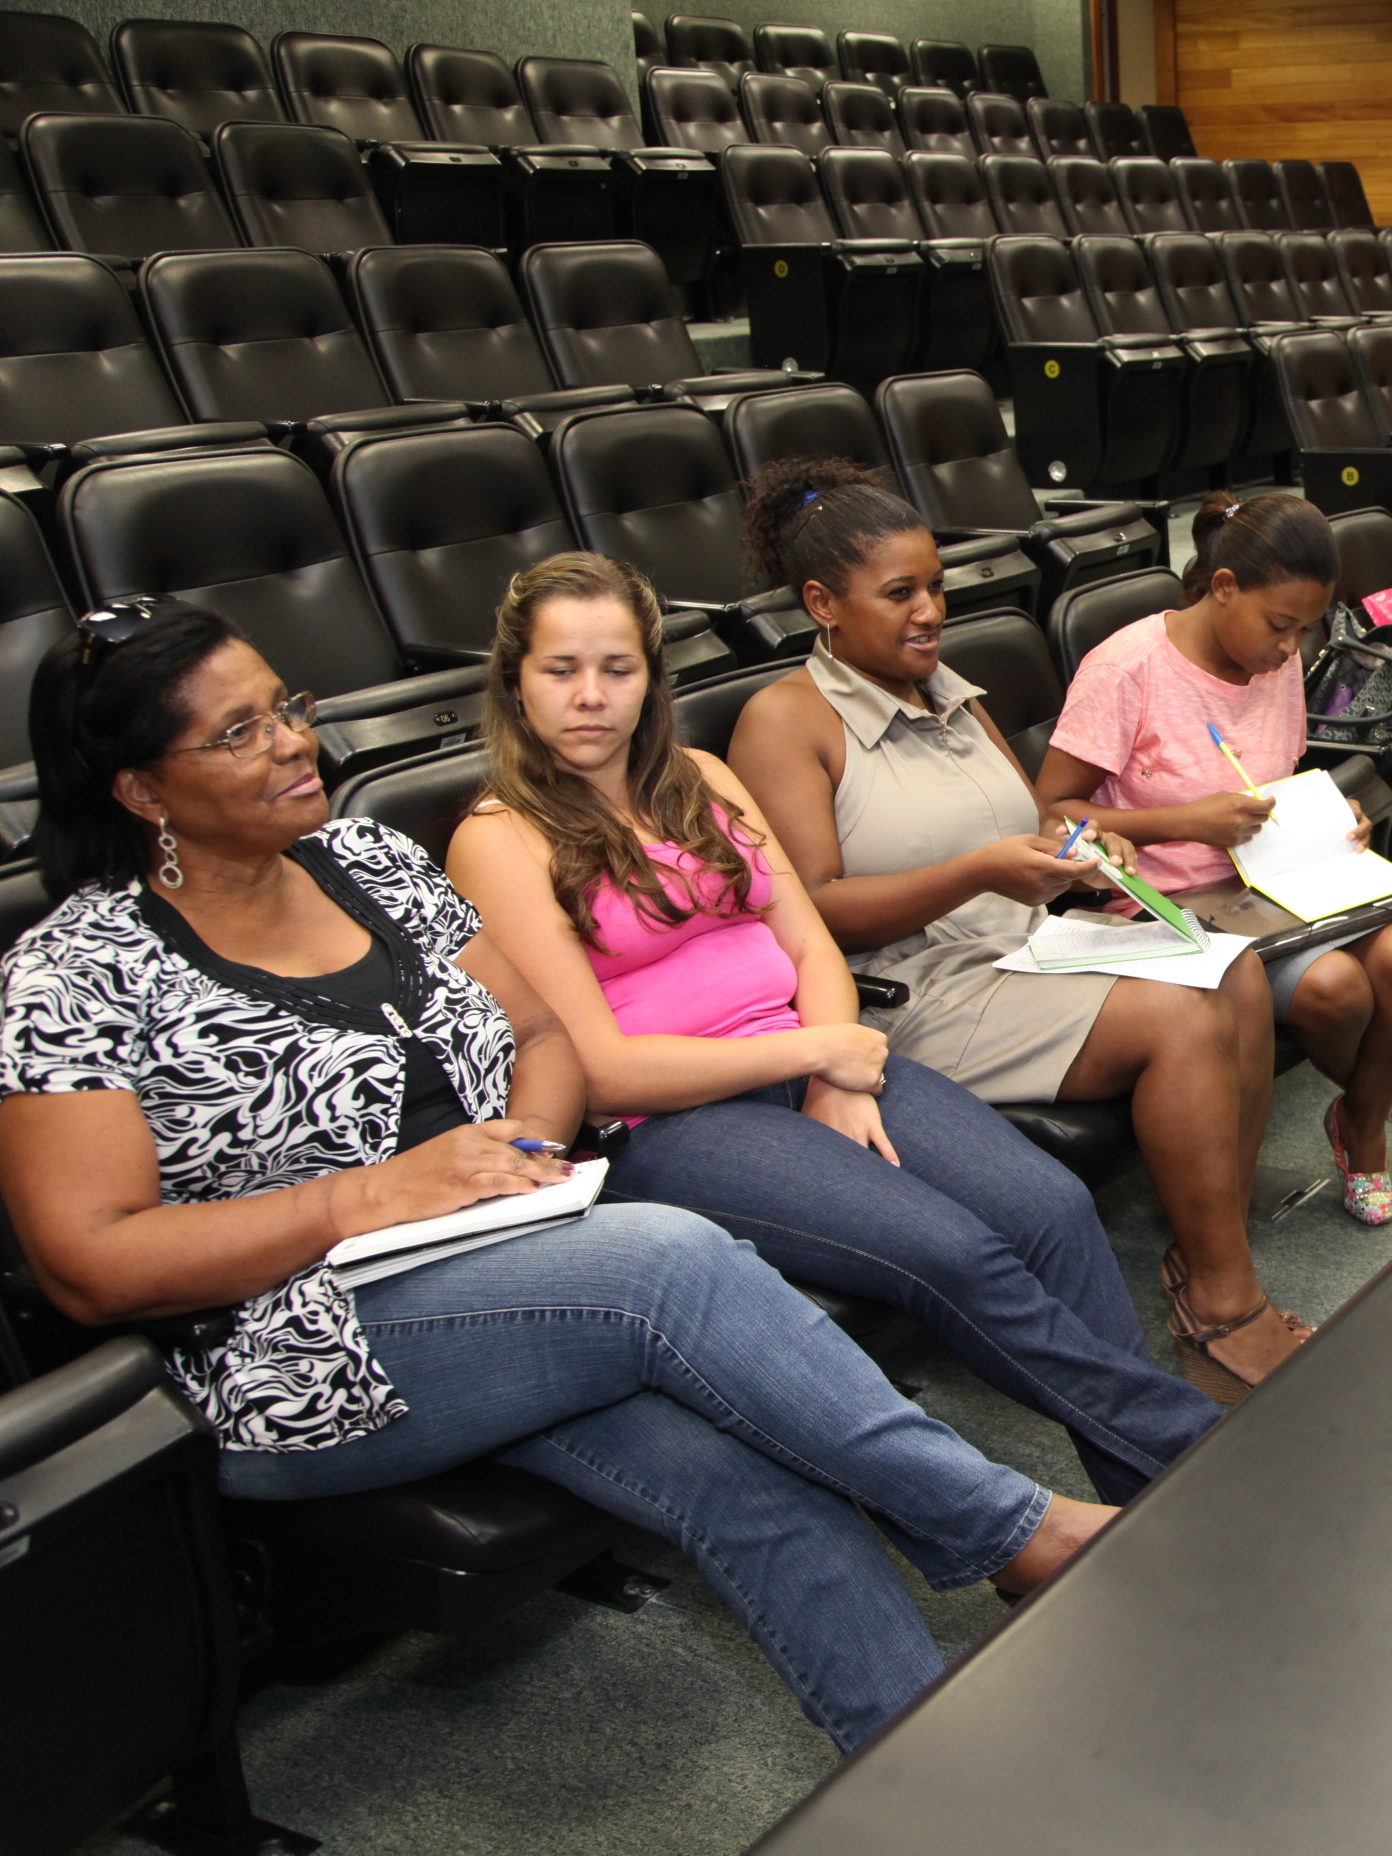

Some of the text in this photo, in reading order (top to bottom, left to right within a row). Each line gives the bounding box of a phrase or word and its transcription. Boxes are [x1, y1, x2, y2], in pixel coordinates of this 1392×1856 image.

[778, 264, 785, 273] D
[1049, 364, 1056, 373] C
[1346, 471, 1354, 481] B
[440, 714, 451, 723] 06
